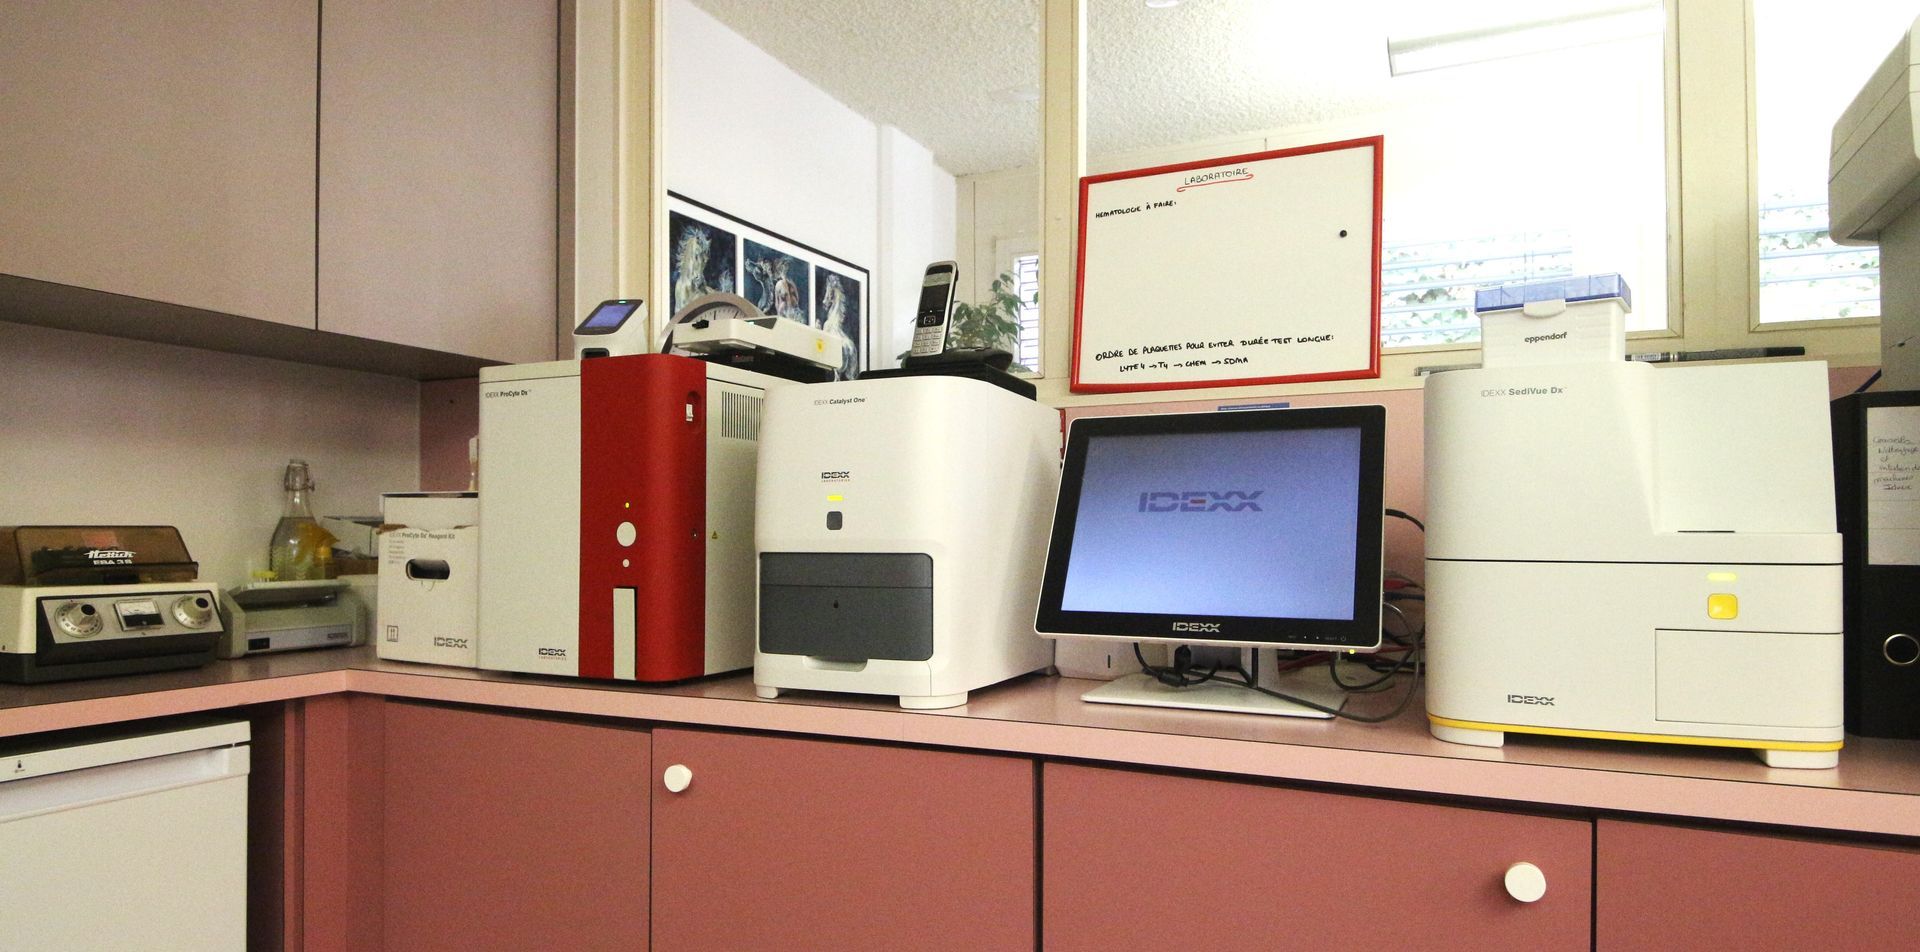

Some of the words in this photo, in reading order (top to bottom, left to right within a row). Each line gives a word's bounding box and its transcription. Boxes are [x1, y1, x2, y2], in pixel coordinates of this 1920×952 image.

[1184, 167, 1249, 186] LABORATOIRE
[1095, 206, 1142, 219] HEMATOLOGIE
[1146, 202, 1151, 210] À
[1524, 331, 1567, 343] eppendorf
[1095, 349, 1124, 361] ORDRE
[1128, 348, 1138, 356] DE
[1142, 343, 1182, 354] PLAQUETTES
[1186, 342, 1204, 350] POUR
[1240, 336, 1269, 346] DURÉE
[1157, 361, 1168, 369] T4
[1223, 357, 1249, 365] SDMA
[1481, 388, 1506, 397] IDEXX
[1508, 387, 1548, 396] SediVue
[821, 471, 850, 479] IDEXX
[1138, 490, 1264, 513] IDEXX
[1172, 621, 1221, 633] IDEXX
[433, 636, 468, 649] IDEXX
[538, 647, 567, 657] IDEXX
[1507, 694, 1555, 706] IDEXX
